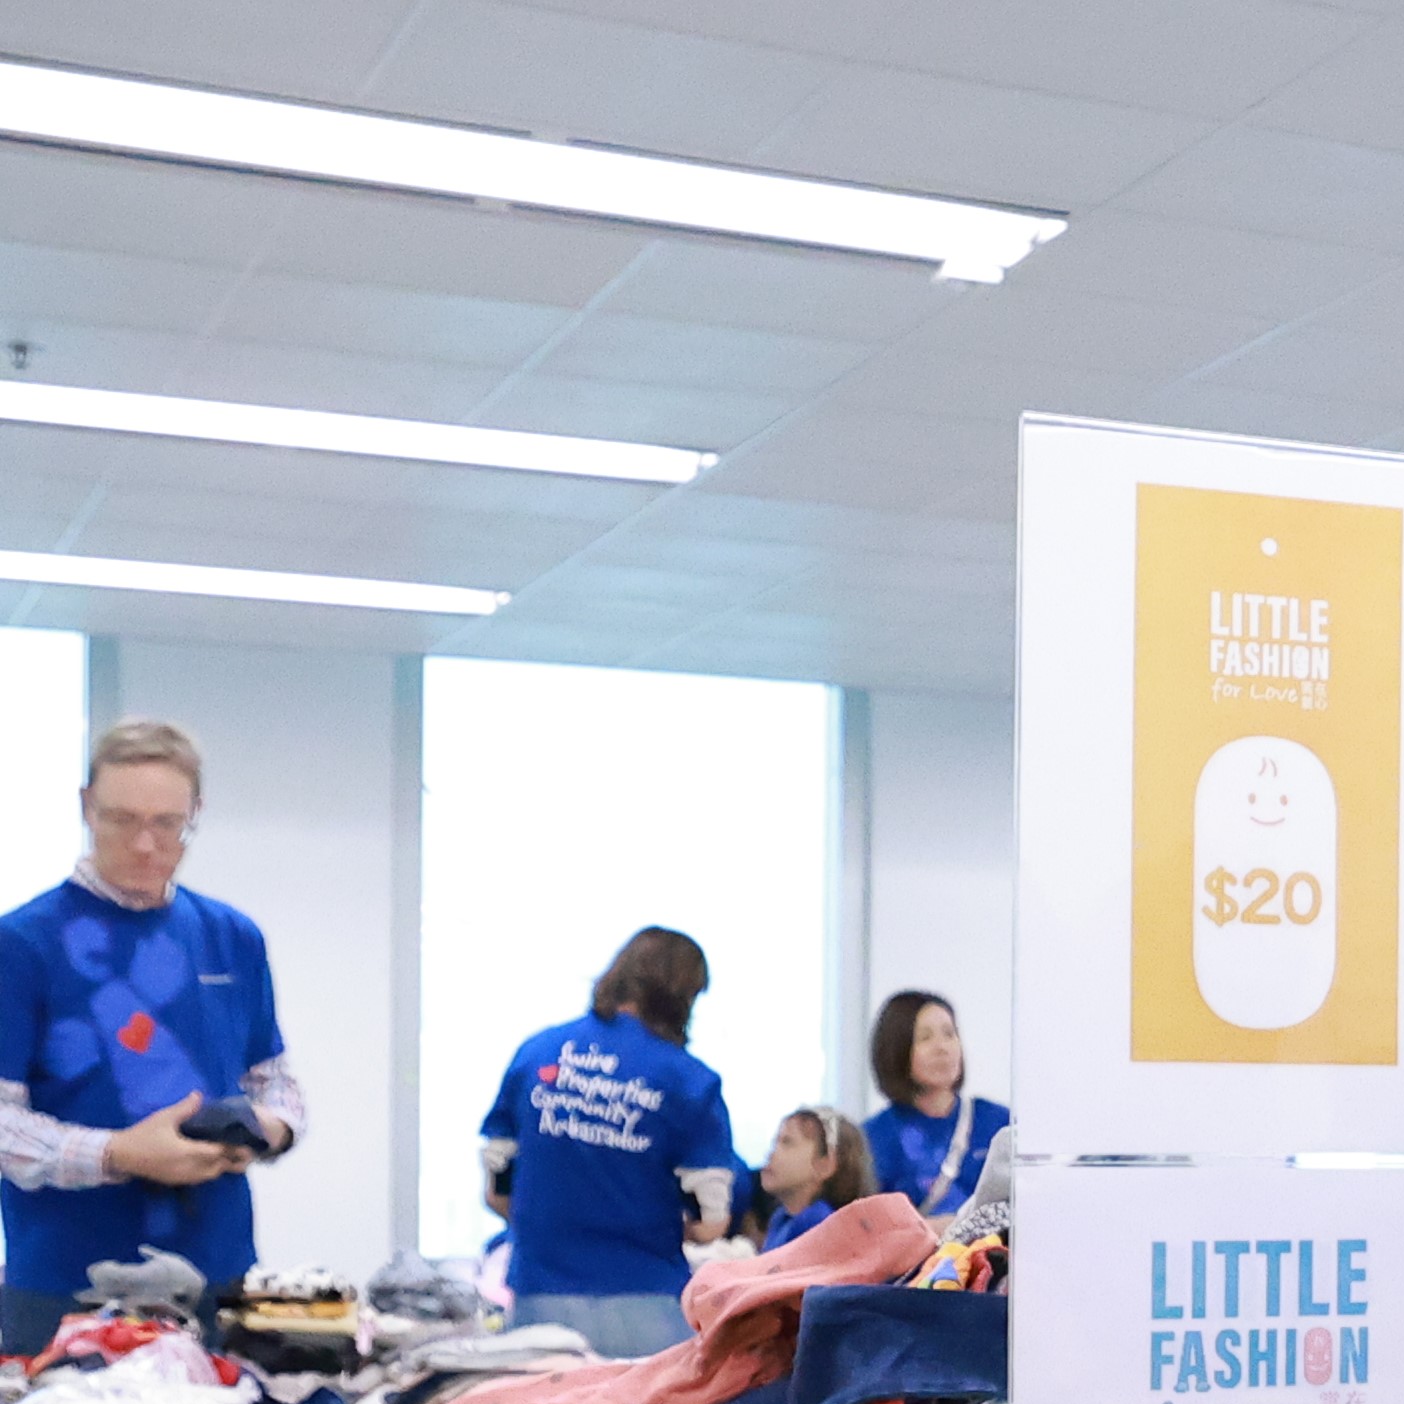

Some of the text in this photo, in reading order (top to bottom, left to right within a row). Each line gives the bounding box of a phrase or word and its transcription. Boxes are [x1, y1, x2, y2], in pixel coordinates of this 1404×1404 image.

[1209, 590, 1330, 643] LITTLE
[1209, 638, 1330, 681] FASHION
[1211, 677, 1243, 705] for
[1250, 684, 1299, 703] Love
[1201, 865, 1323, 928] $20
[1151, 1238, 1369, 1319] LITTLE
[1150, 1326, 1369, 1393] FASHION
